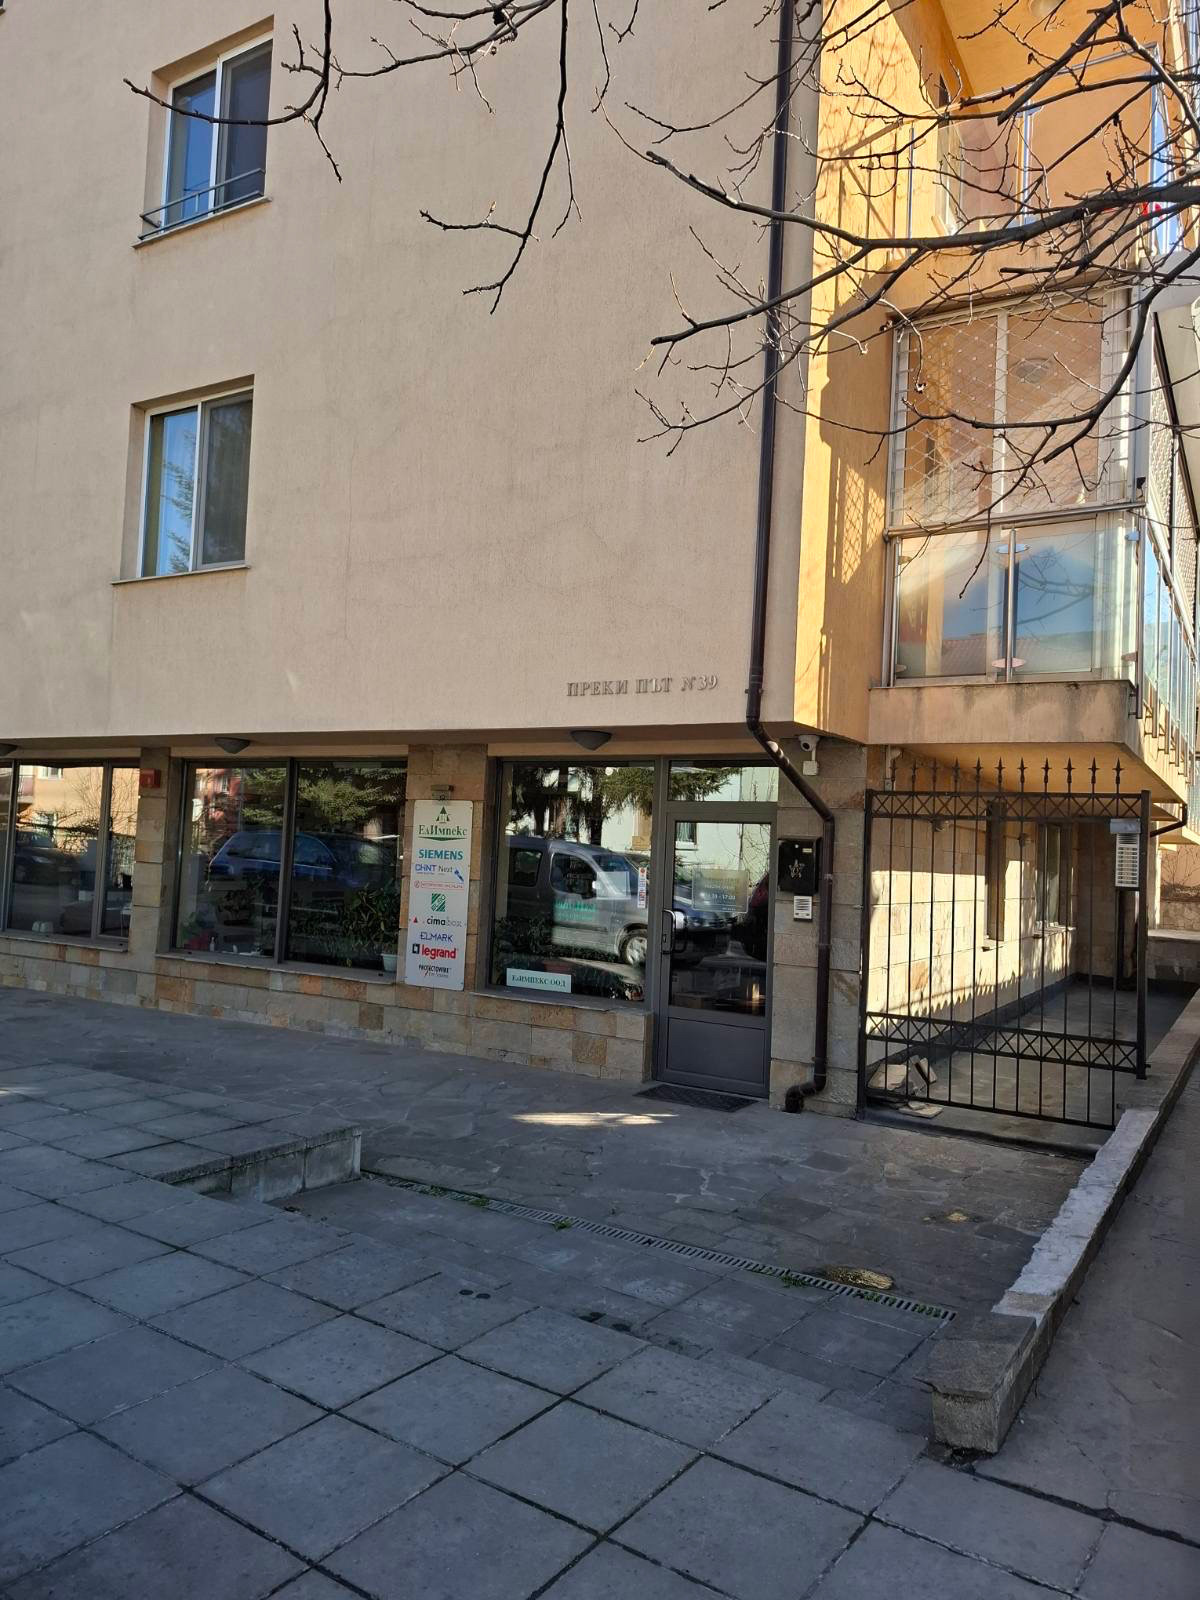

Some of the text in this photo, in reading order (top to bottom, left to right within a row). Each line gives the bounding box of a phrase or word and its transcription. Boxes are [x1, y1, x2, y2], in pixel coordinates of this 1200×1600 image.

[567, 680, 628, 697] ПРЕКИ
[635, 677, 673, 694] ПЪТ
[418, 849, 464, 860] SIEMENS
[420, 931, 453, 943] ELMARK
[421, 944, 457, 960] legrand
